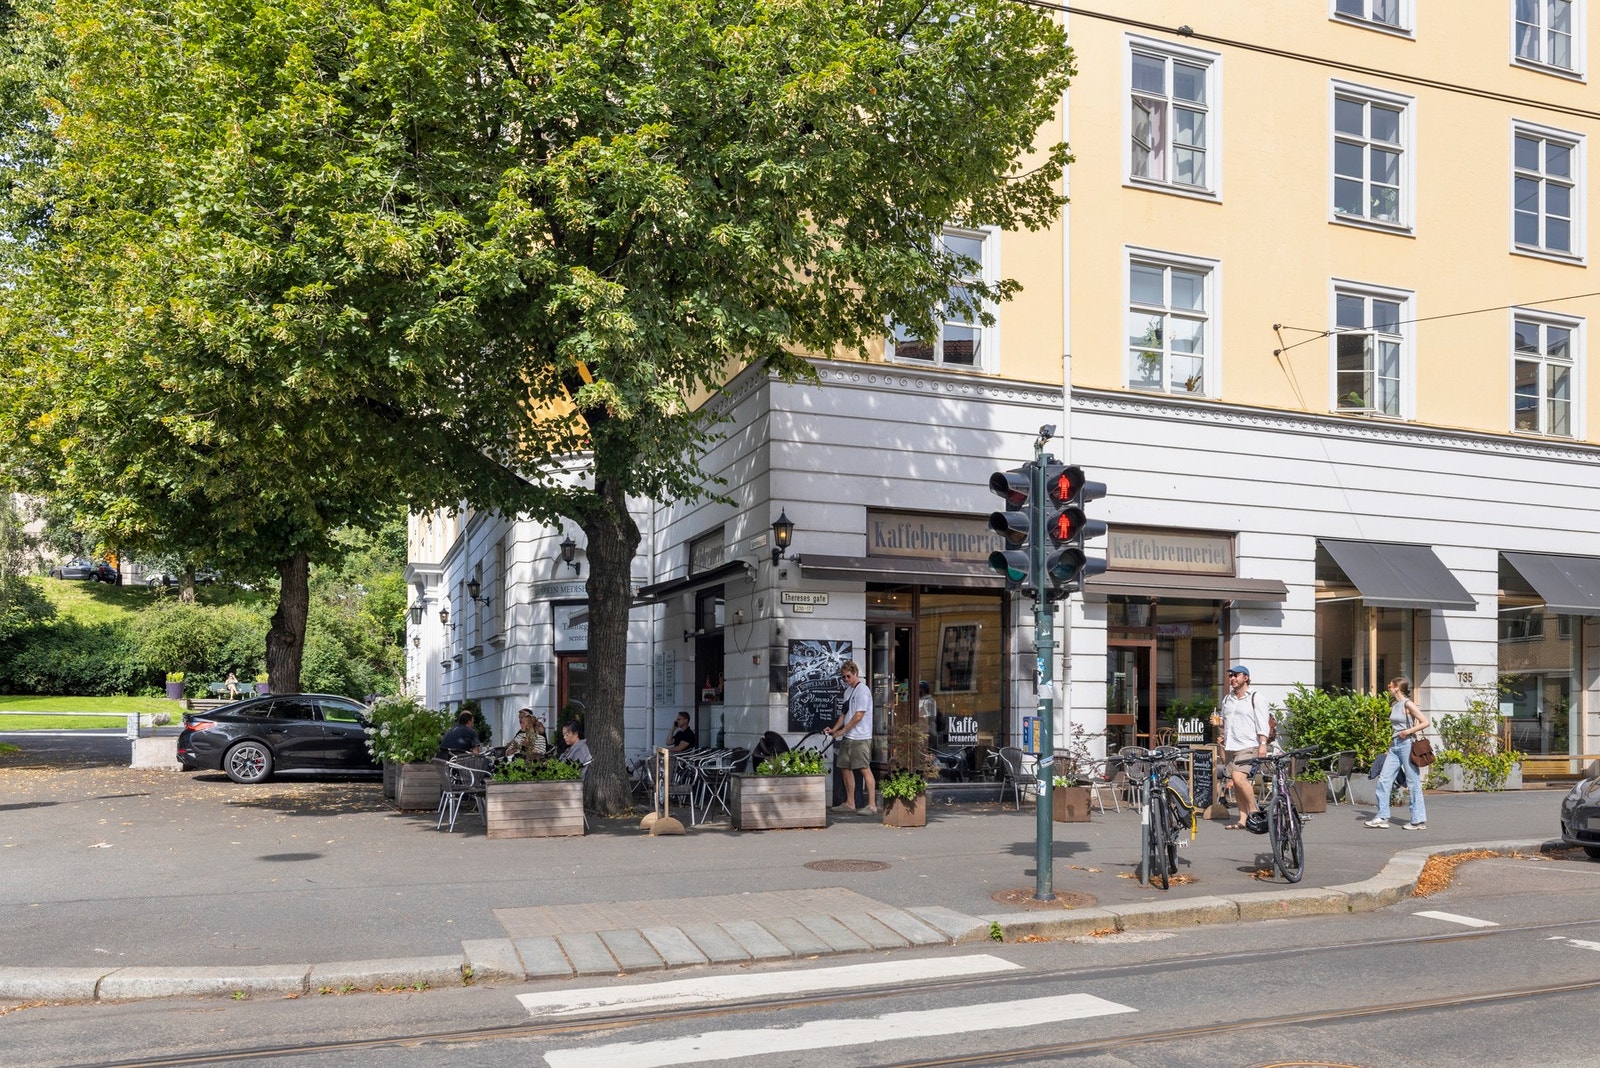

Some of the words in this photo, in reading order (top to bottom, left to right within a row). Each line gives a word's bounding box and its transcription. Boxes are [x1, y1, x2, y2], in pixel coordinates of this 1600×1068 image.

[1112, 537, 1226, 565] Kaffebrenneriet
[785, 594, 810, 602] Thereses
[813, 595, 826, 604] gate
[1457, 672, 1473, 683] T35
[948, 716, 978, 733] Kaffe
[1178, 718, 1204, 733] Kaffe
[948, 733, 978, 742] brenneriet
